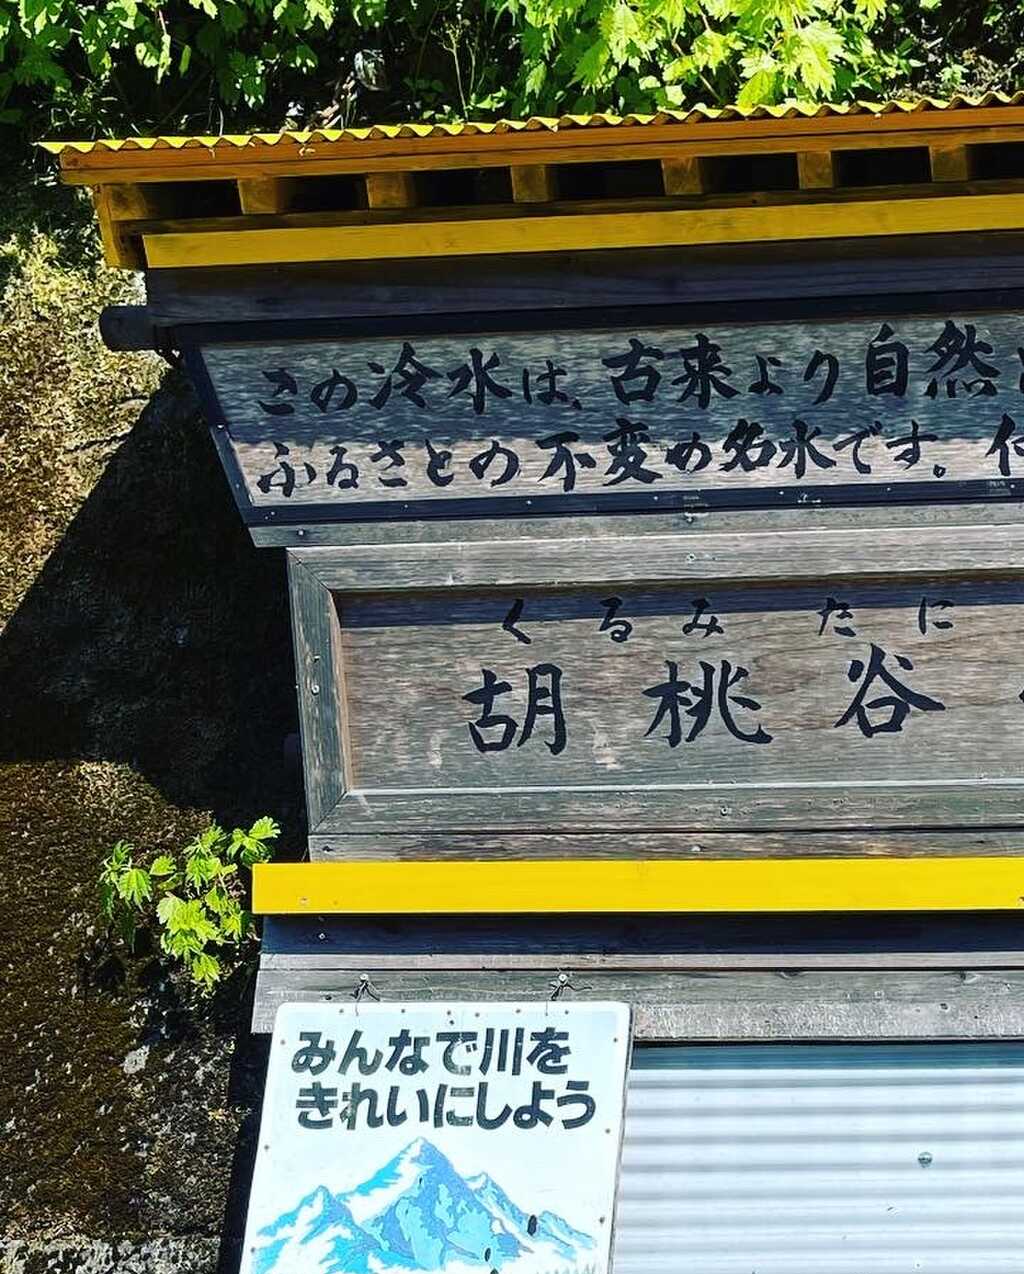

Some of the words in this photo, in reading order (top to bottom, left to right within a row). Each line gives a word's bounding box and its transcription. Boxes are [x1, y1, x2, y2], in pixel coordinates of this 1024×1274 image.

[291, 1026, 571, 1076] みんなで川を
[296, 1081, 596, 1130] きれいにしよう
